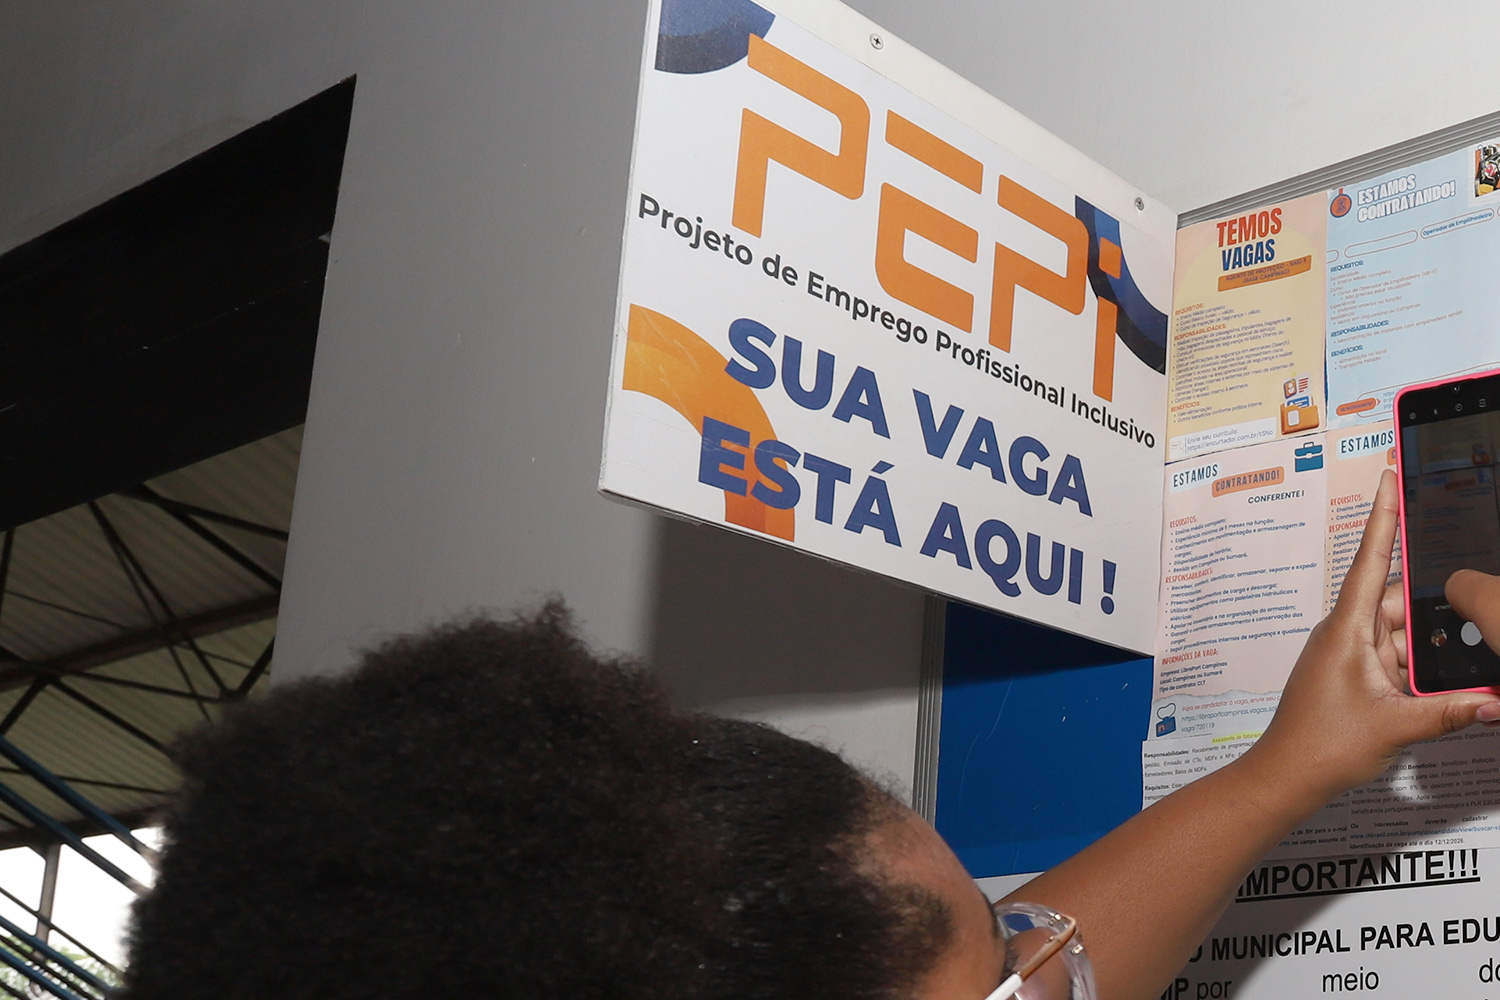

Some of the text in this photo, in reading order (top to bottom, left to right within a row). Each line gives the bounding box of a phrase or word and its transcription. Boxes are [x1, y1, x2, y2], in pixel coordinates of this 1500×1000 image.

[1357, 174, 1416, 205] ESTAMOS
[1357, 180, 1456, 223] CONTRATANDO!
[1217, 208, 1282, 248] TEMOS
[1221, 239, 1275, 272] VAGAS
[638, 192, 1156, 450] Projeto de Emprego Profissional Inclusivo
[725, 318, 1094, 518] SUA VAGA
[1173, 464, 1218, 488] ESTAMOS
[1215, 470, 1280, 491] CONTRATANDO!
[1248, 491, 1300, 504] CONFERENTE
[699, 416, 1116, 616] ESTÁ AQUI !
[1210, 930, 1351, 962] MUNICIPAL
[1359, 920, 1436, 951] PARA
[1321, 968, 1380, 993] meio
